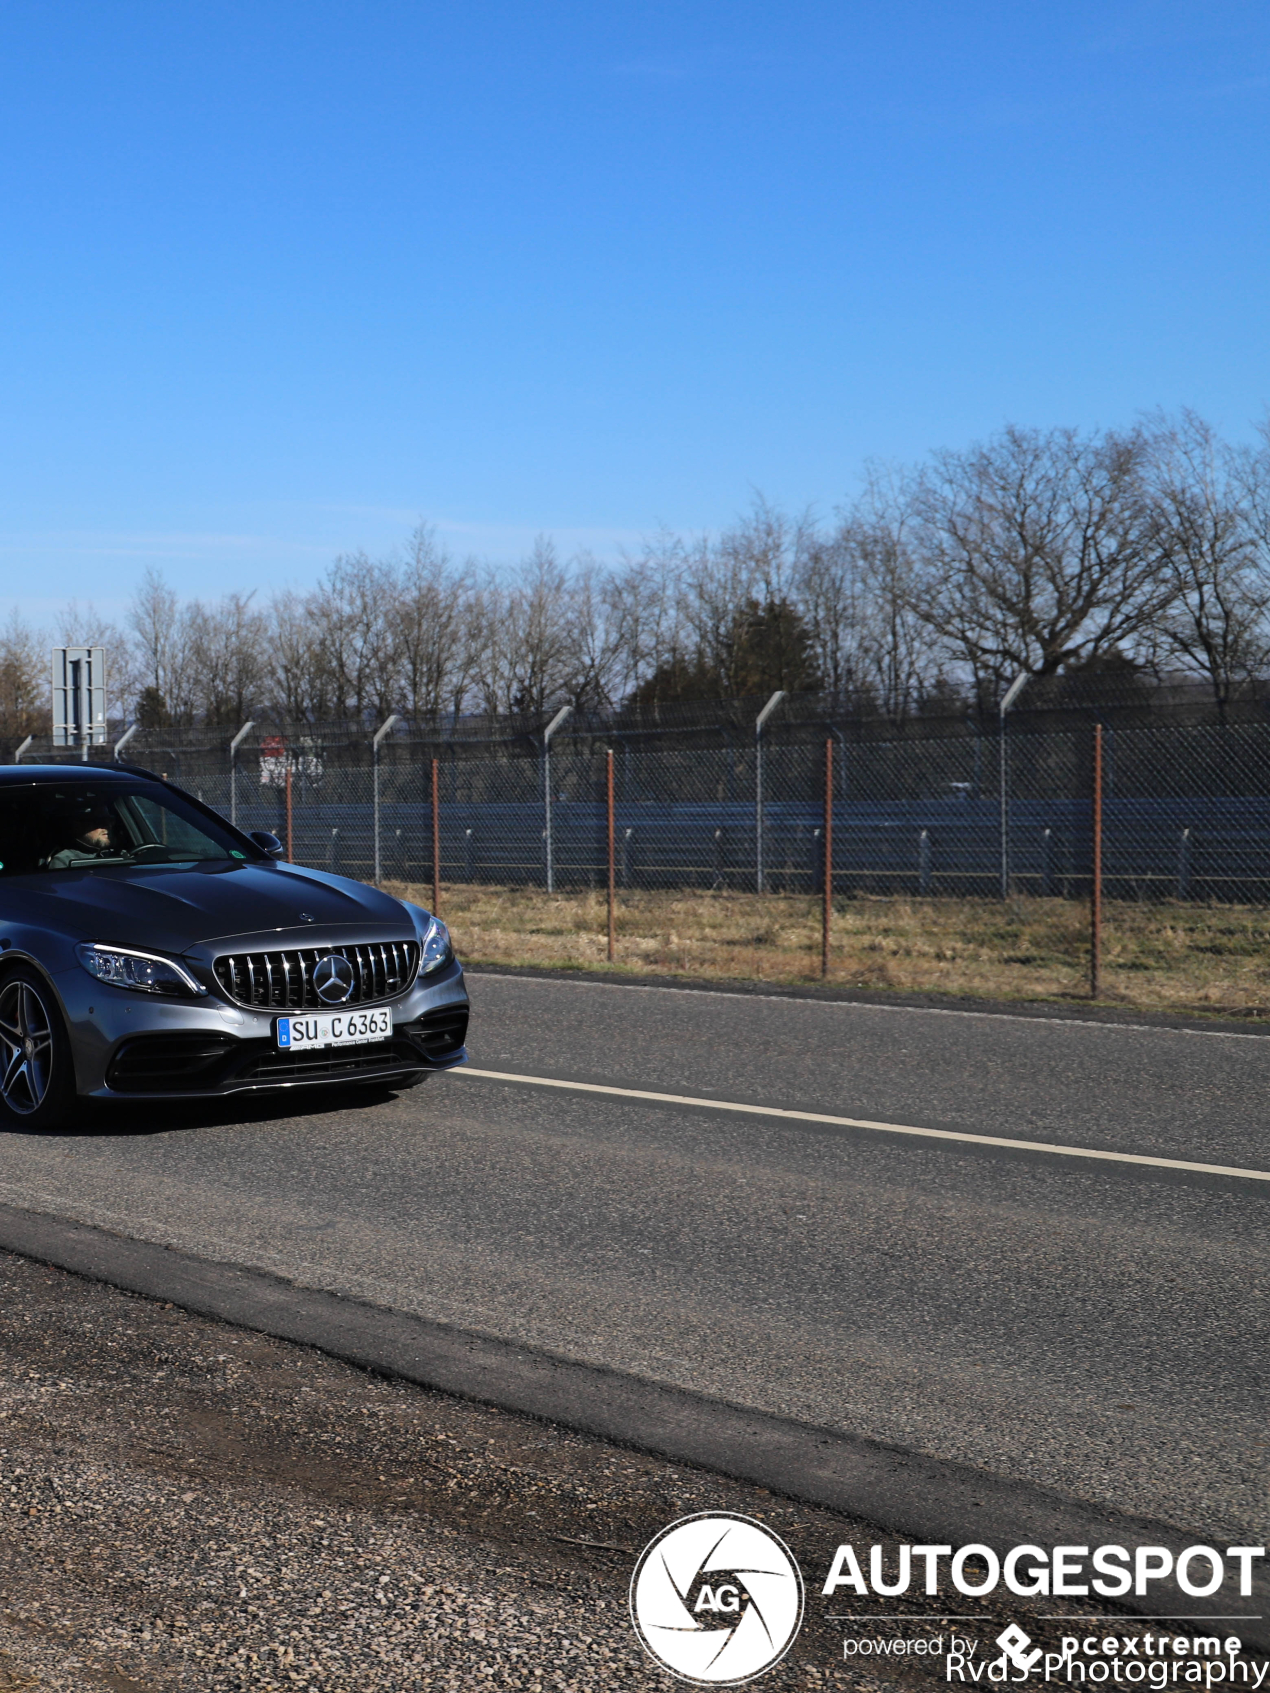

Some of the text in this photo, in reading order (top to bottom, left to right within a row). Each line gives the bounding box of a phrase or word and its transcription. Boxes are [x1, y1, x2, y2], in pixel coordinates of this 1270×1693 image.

[292, 1019, 318, 1042] SU
[331, 1018, 343, 1038] C
[347, 1012, 388, 1037] 6363
